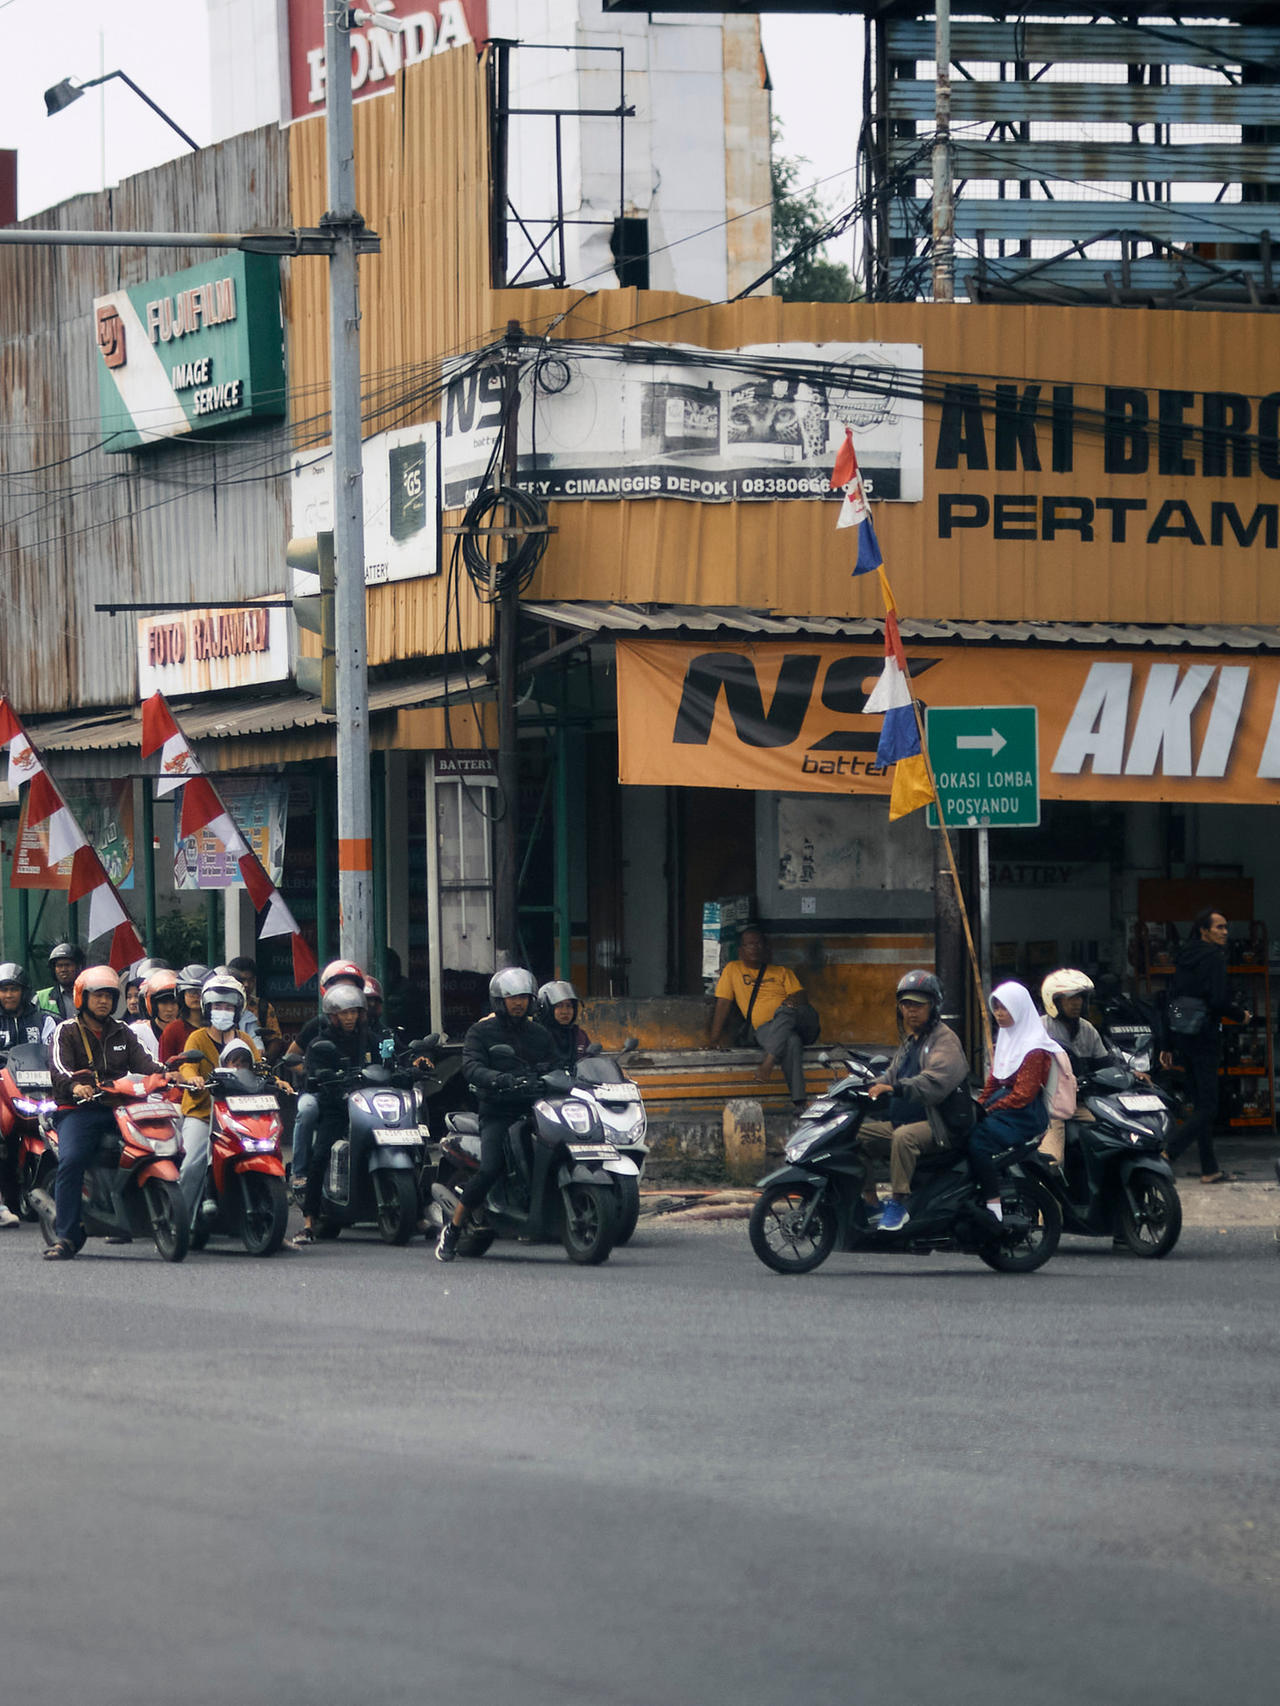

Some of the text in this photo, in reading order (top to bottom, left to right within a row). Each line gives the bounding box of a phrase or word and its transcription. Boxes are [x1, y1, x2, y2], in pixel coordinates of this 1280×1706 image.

[147, 278, 236, 343] FUJIFILM
[172, 358, 210, 391] IMAGE
[193, 380, 240, 415] SERVICE
[935, 383, 1074, 473] AKI
[565, 476, 661, 494] CIMANGGIS
[667, 477, 728, 496] DEPOK
[742, 479, 873, 493] 083806665
[938, 494, 1278, 548] PERTAM
[365, 562, 389, 580] ATTERY
[149, 622, 185, 667] FOTO
[673, 652, 944, 750] NS
[1051, 662, 1250, 777] AKI
[801, 755, 897, 777] batter
[933, 771, 1033, 789] LOKASI LOMBA
[947, 797, 1019, 815] POSYANDU
